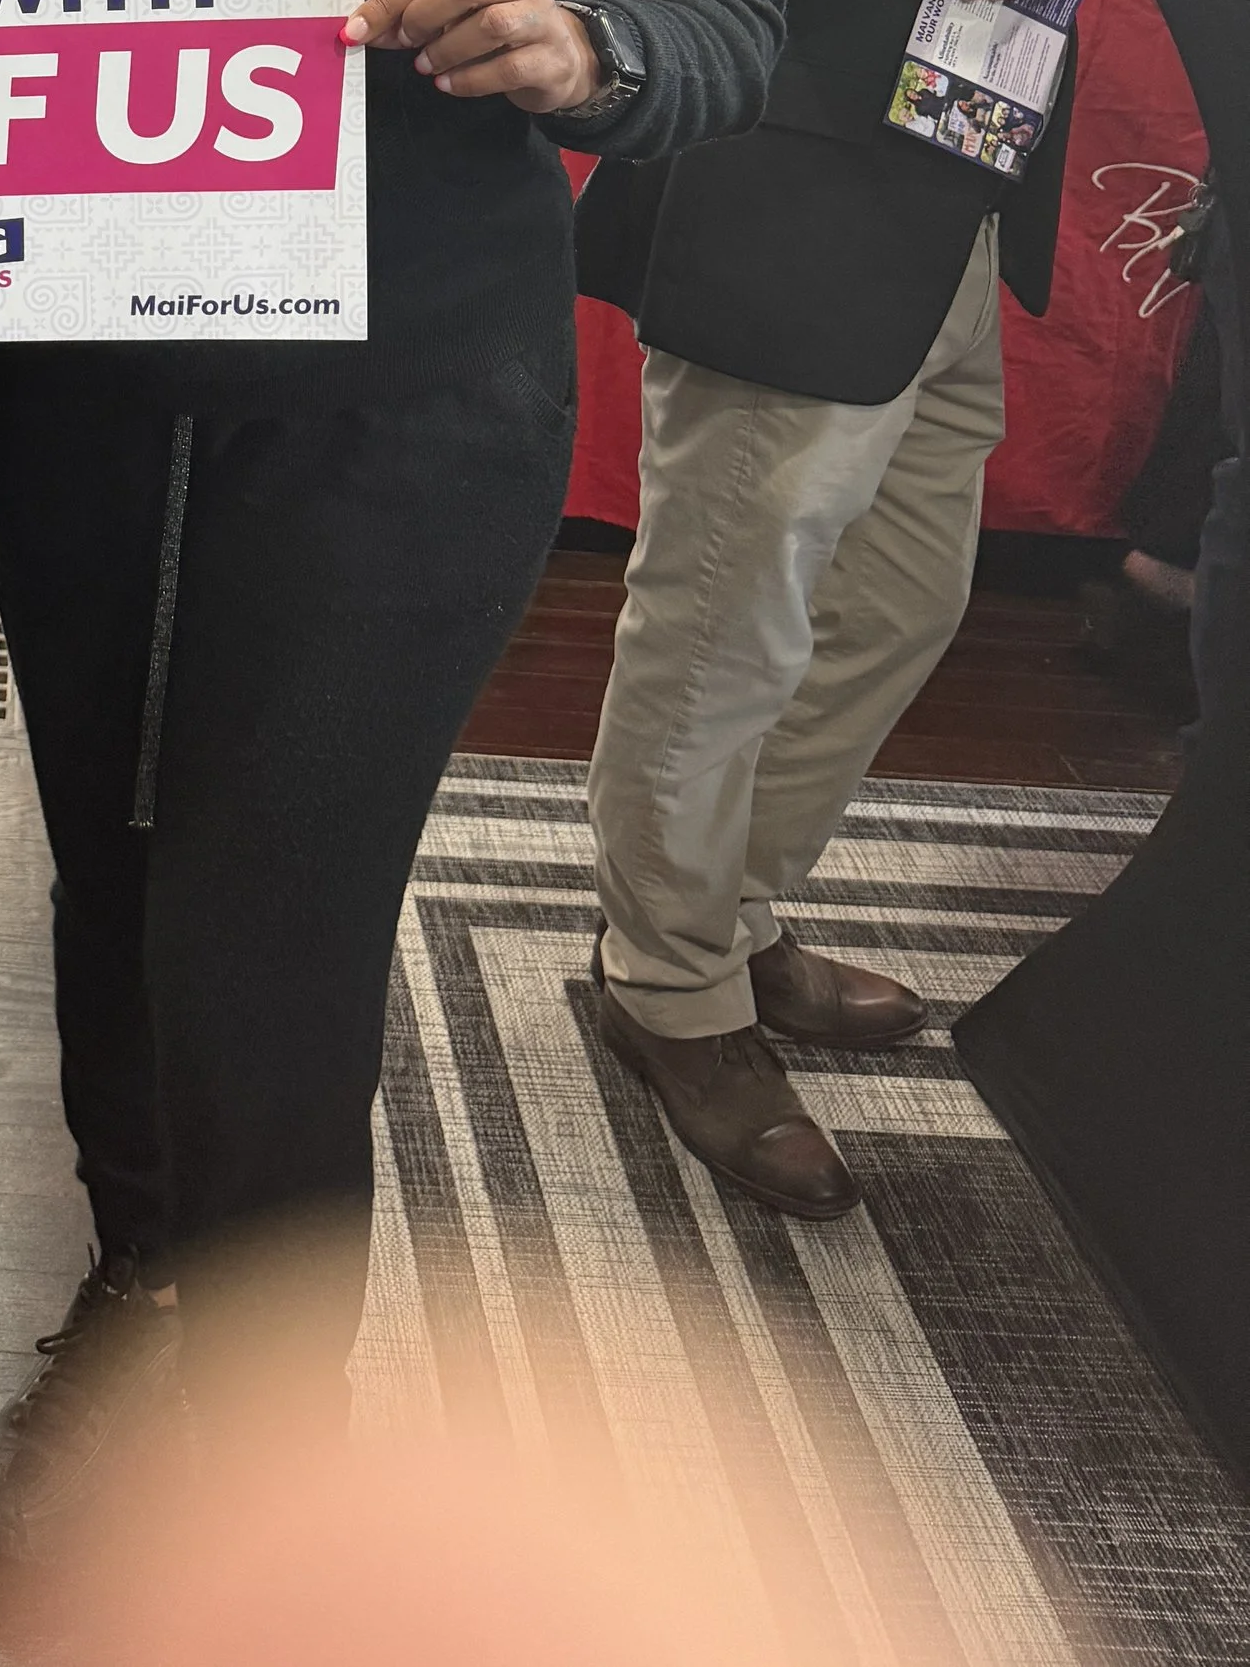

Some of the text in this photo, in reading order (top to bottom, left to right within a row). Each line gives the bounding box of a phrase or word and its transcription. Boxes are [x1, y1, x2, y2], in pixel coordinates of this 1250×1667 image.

[916, 21, 928, 42] MAI
[925, 19, 938, 43] OUR
[95, 44, 305, 164] US
[131, 294, 340, 316] MaiForUs.com
